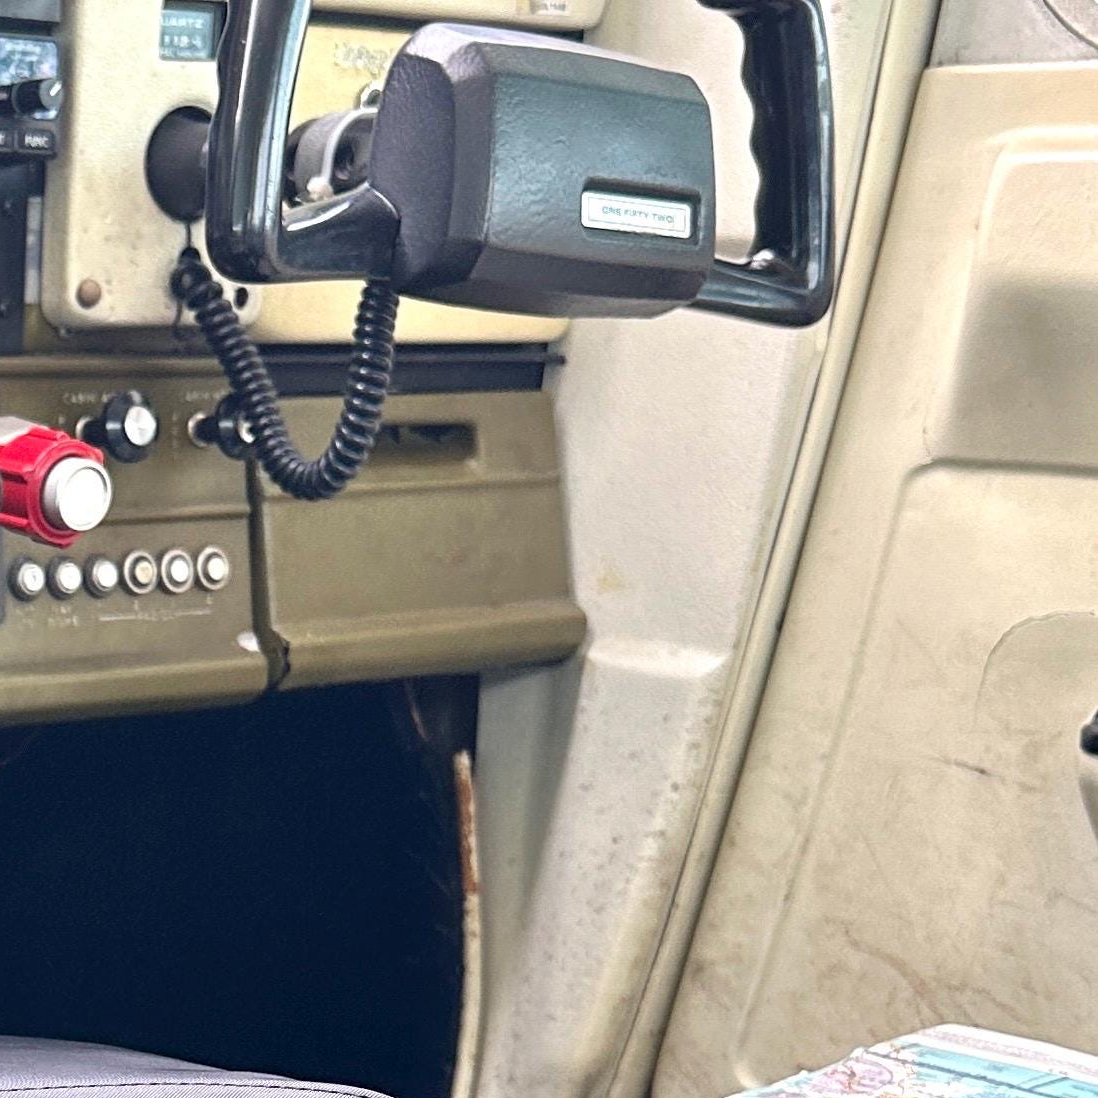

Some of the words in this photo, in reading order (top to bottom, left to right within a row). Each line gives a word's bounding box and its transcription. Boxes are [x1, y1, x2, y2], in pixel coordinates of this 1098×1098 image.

[601, 205, 622, 216] ONE
[624, 209, 649, 219] FIFTY
[652, 213, 674, 224] TWO
